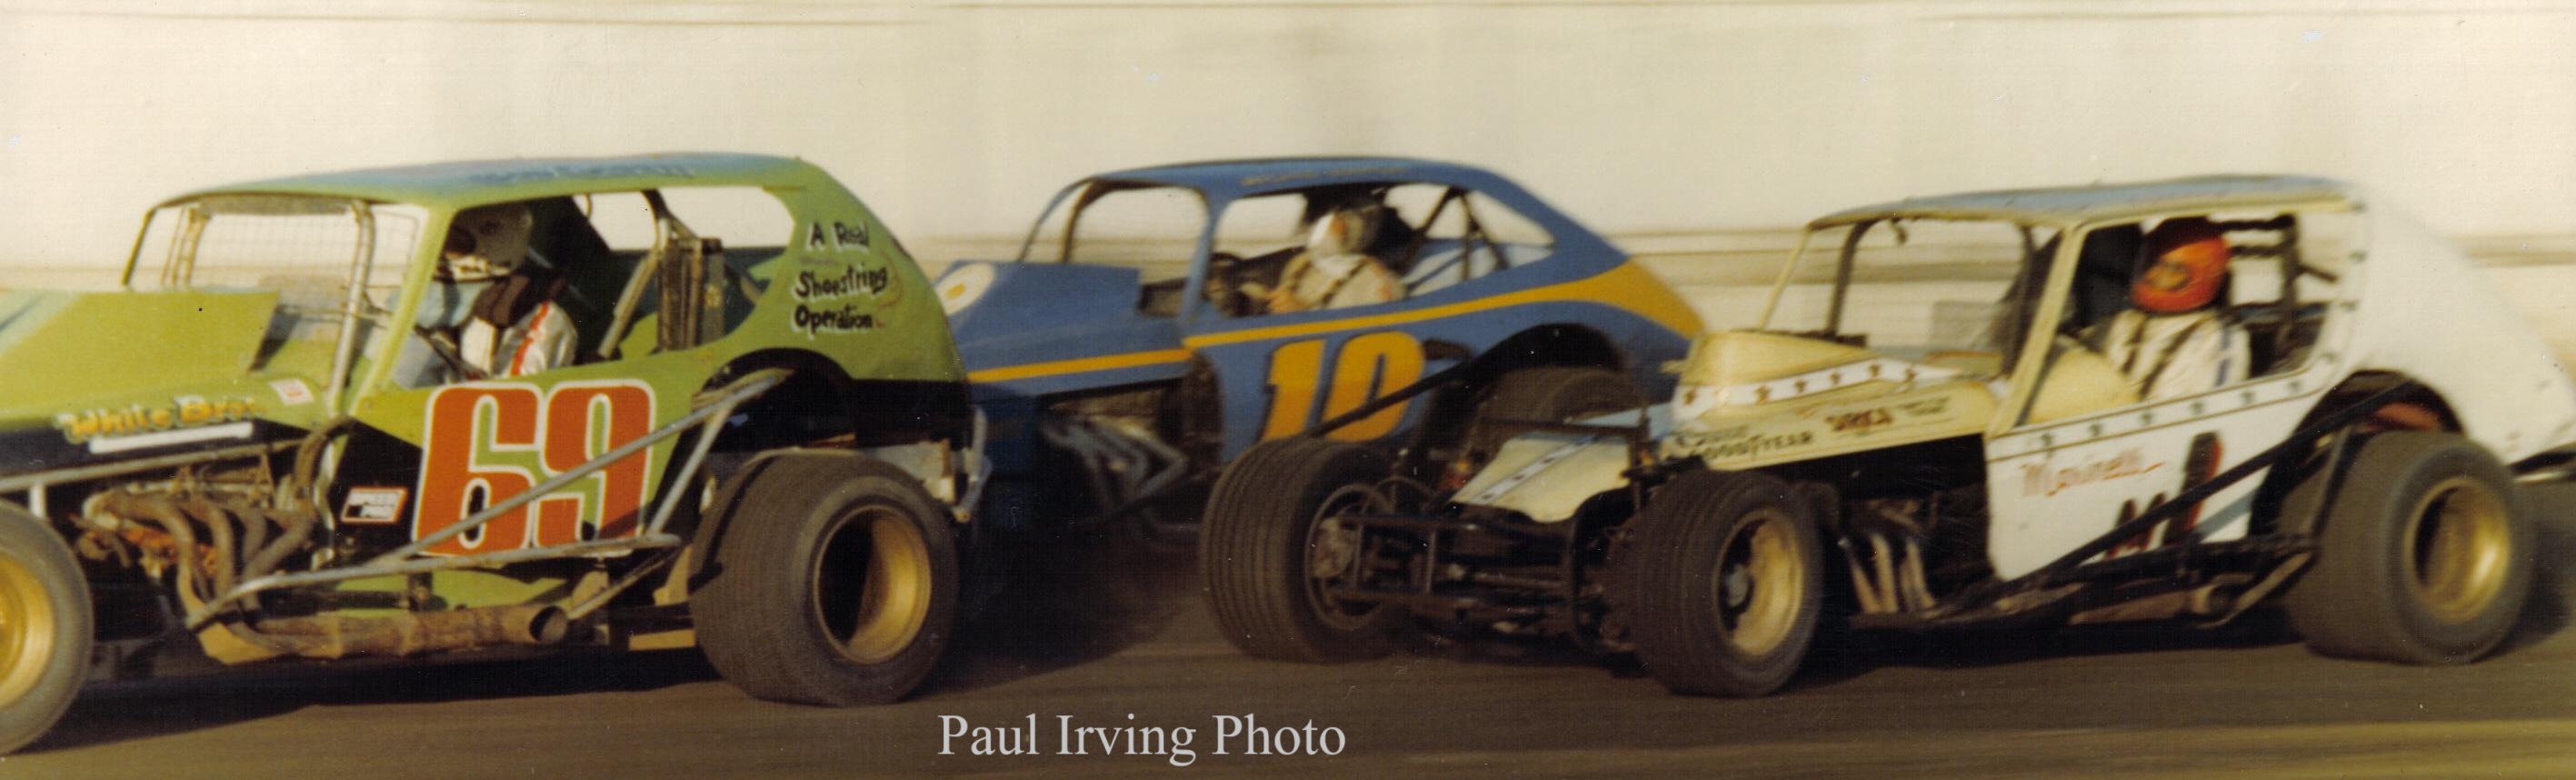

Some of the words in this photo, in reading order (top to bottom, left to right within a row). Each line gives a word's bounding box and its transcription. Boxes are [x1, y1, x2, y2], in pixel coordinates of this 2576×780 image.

[806, 222, 826, 250] A
[794, 264, 888, 301] Shoestring
[794, 304, 874, 338] Operation
[1263, 330, 1426, 443] 10
[411, 378, 656, 558] 69
